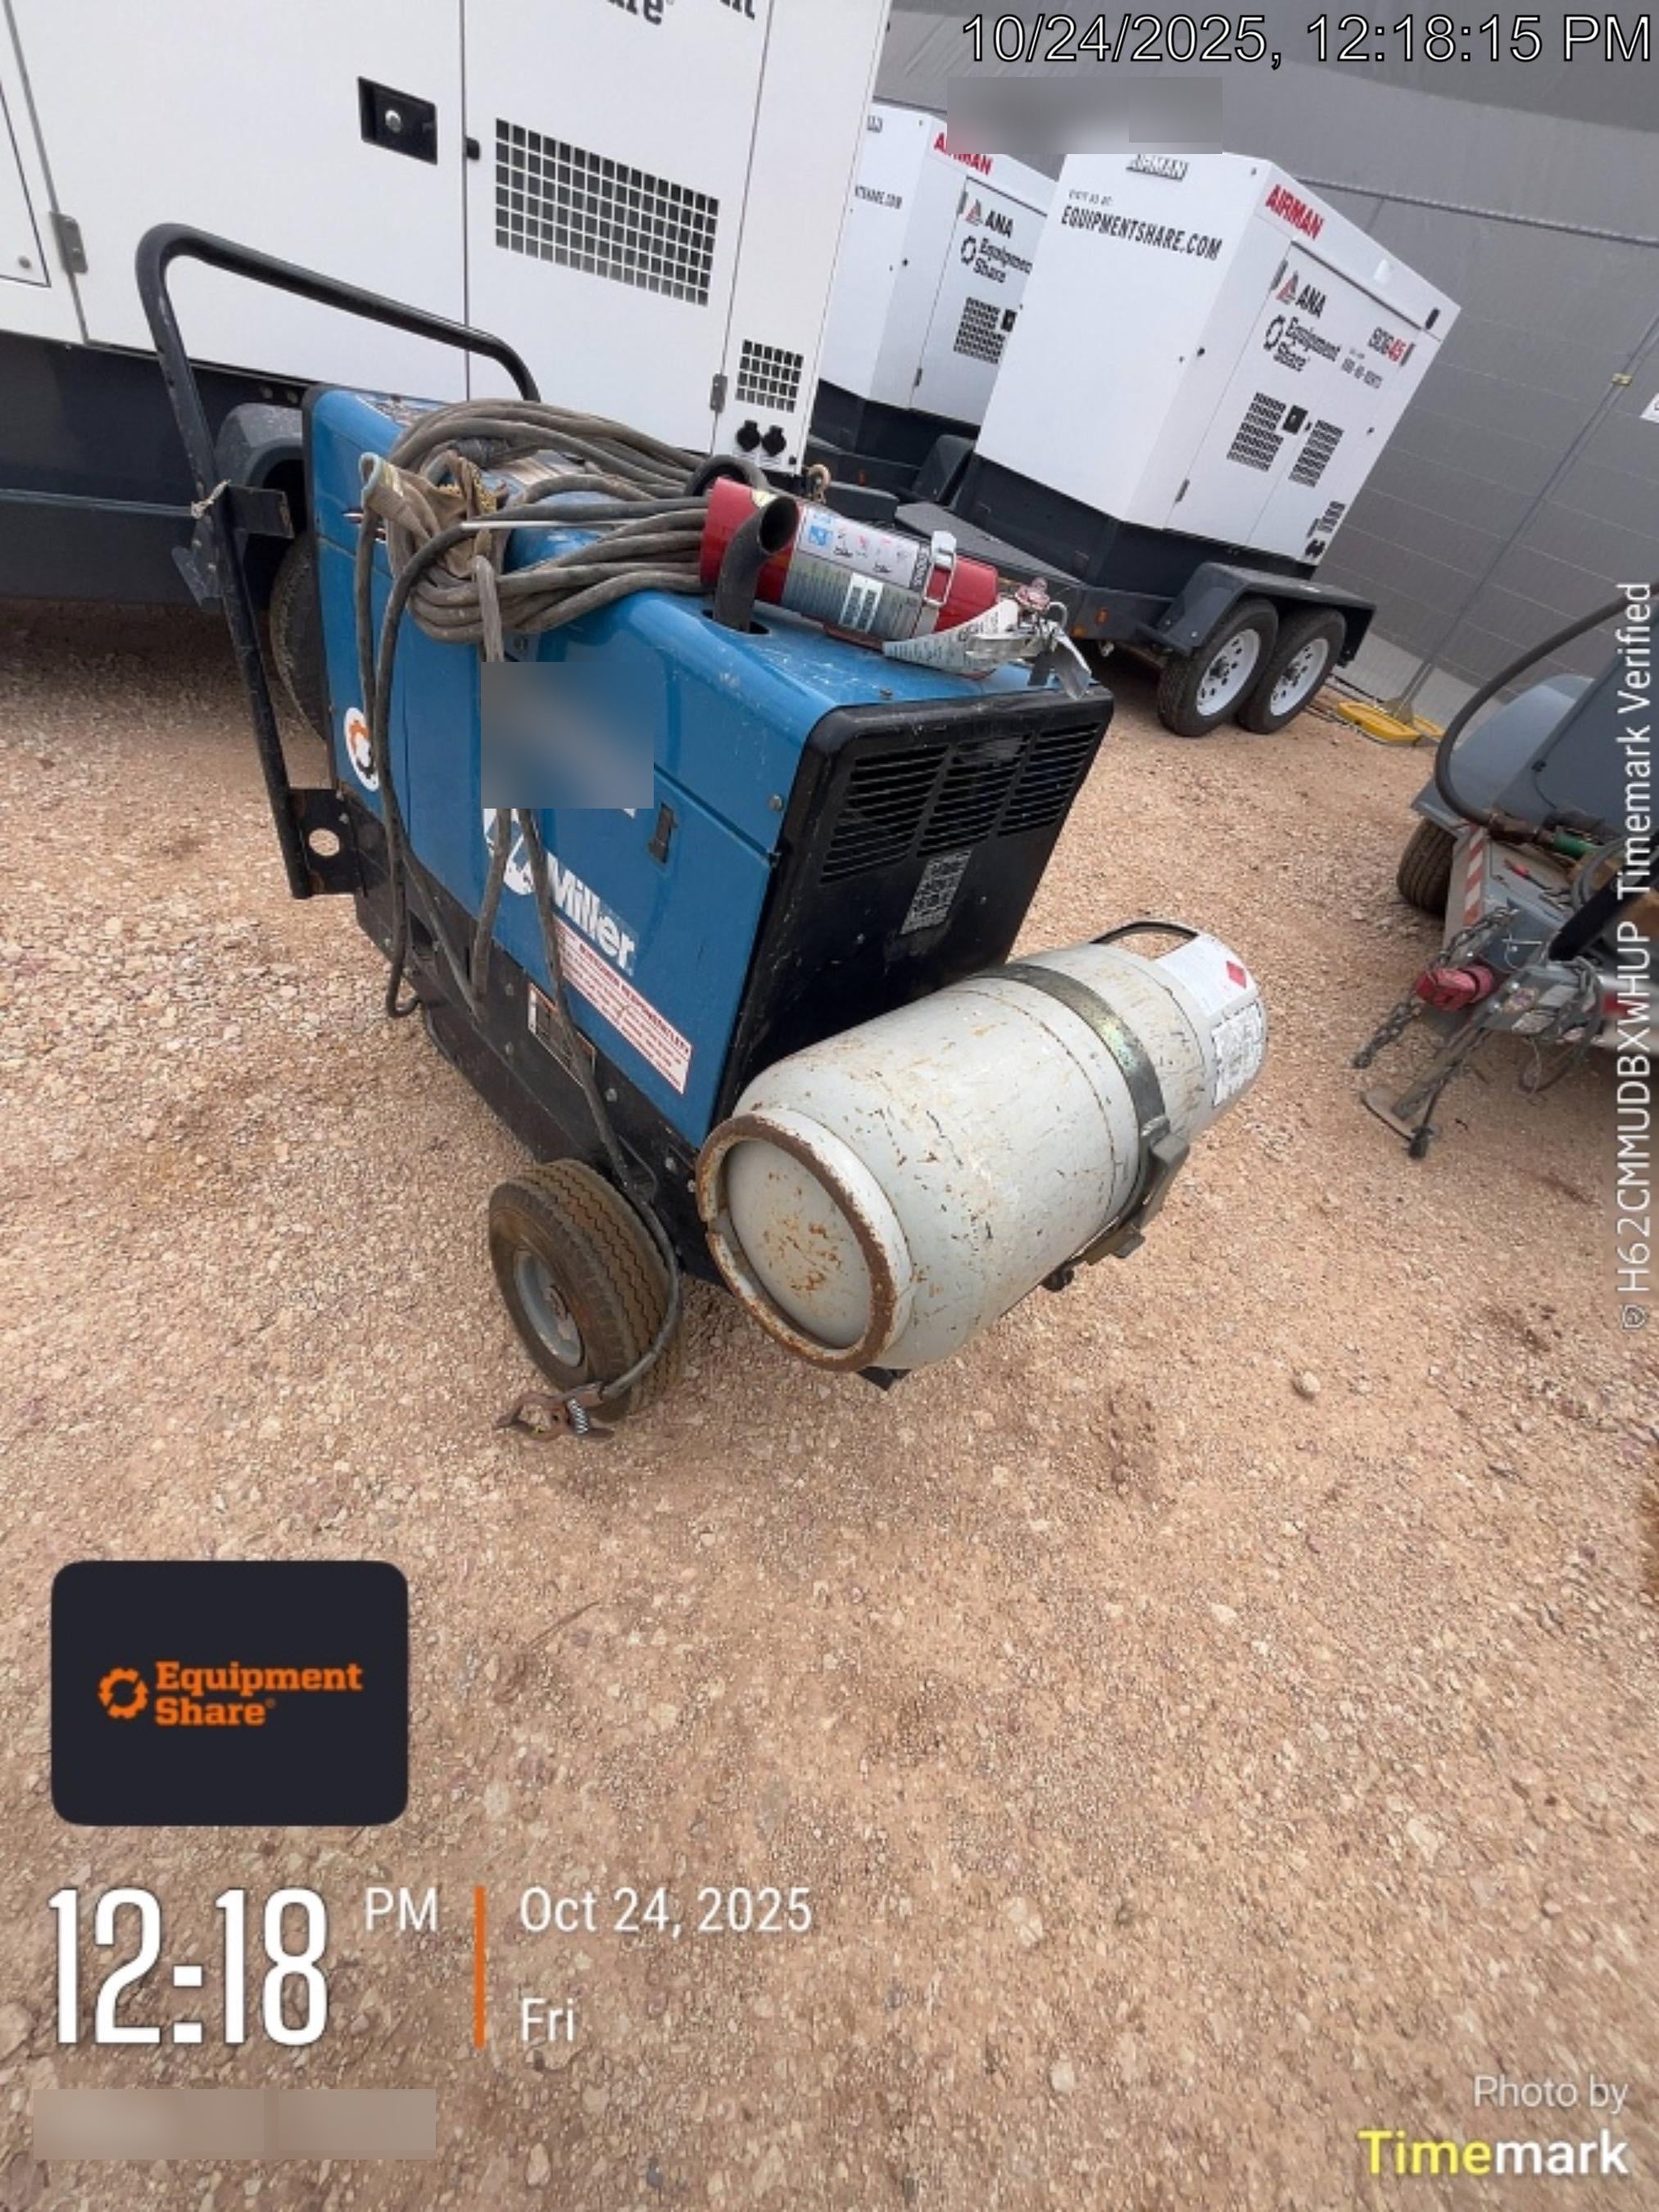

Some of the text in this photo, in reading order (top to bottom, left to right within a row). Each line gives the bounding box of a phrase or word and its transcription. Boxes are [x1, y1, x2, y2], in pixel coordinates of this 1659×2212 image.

[985, 210, 1013, 238] ANA
[1061, 205, 1223, 261] EQUIPMENTSHARE.COM
[1265, 184, 1325, 241] AIRMAN
[978, 238, 1033, 275] Equipmen
[1295, 284, 1326, 319] ANA
[1285, 317, 1341, 362] Equipment
